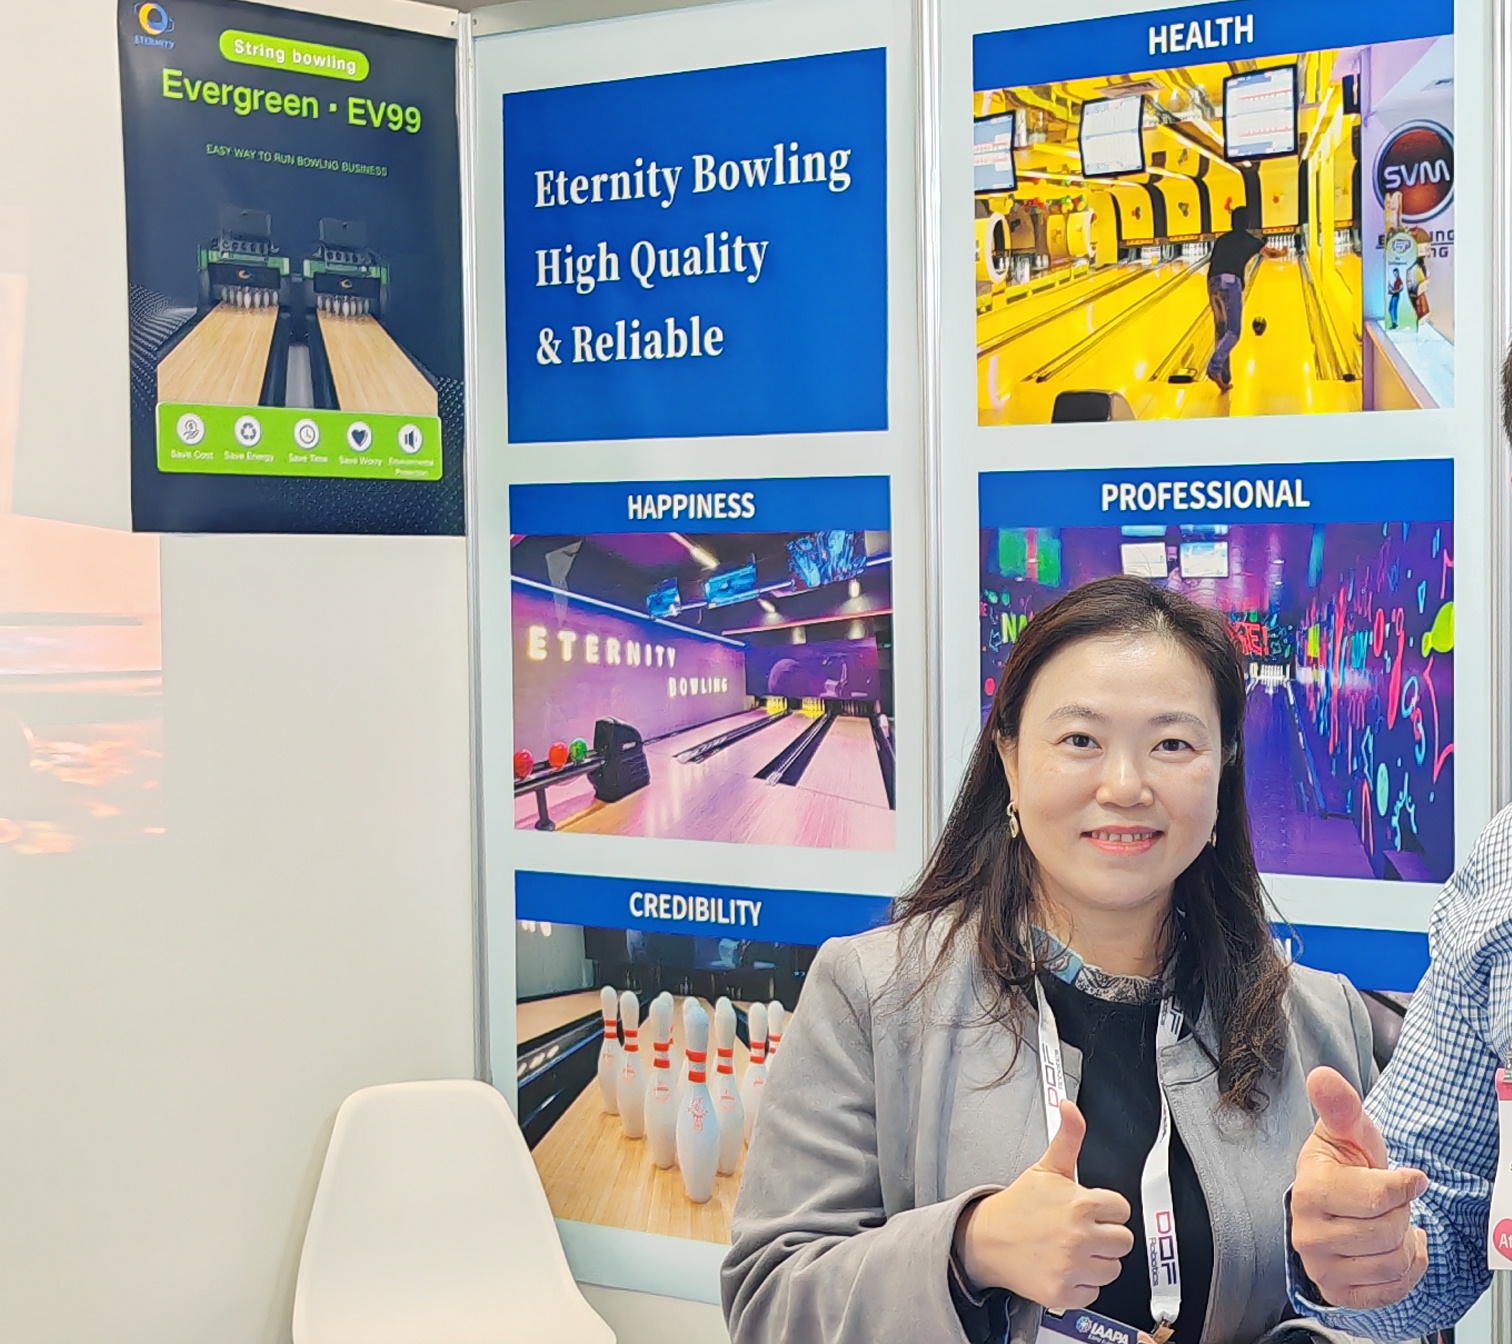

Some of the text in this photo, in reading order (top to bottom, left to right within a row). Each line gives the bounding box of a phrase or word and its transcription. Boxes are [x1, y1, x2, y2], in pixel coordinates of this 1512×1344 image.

[1148, 14, 1254, 55] HEALTH
[234, 39, 356, 75] String bowling
[162, 68, 319, 119] Evergreen
[348, 97, 422, 133] EV99
[206, 144, 231, 156] EASY
[234, 148, 256, 160] WAY
[258, 151, 271, 162] TO
[273, 152, 295, 166] RUN
[534, 141, 852, 209] Eternity Bowling
[1384, 159, 1451, 189] SVM
[535, 231, 769, 295] High Quality
[536, 315, 725, 366] & Reliable
[628, 492, 756, 520] HAPPINESS
[1101, 479, 1311, 512] PROFESSIONAL
[527, 625, 677, 669] ETERNITY
[668, 676, 728, 698] BOWLING
[629, 891, 762, 927] CREDIBILITY
